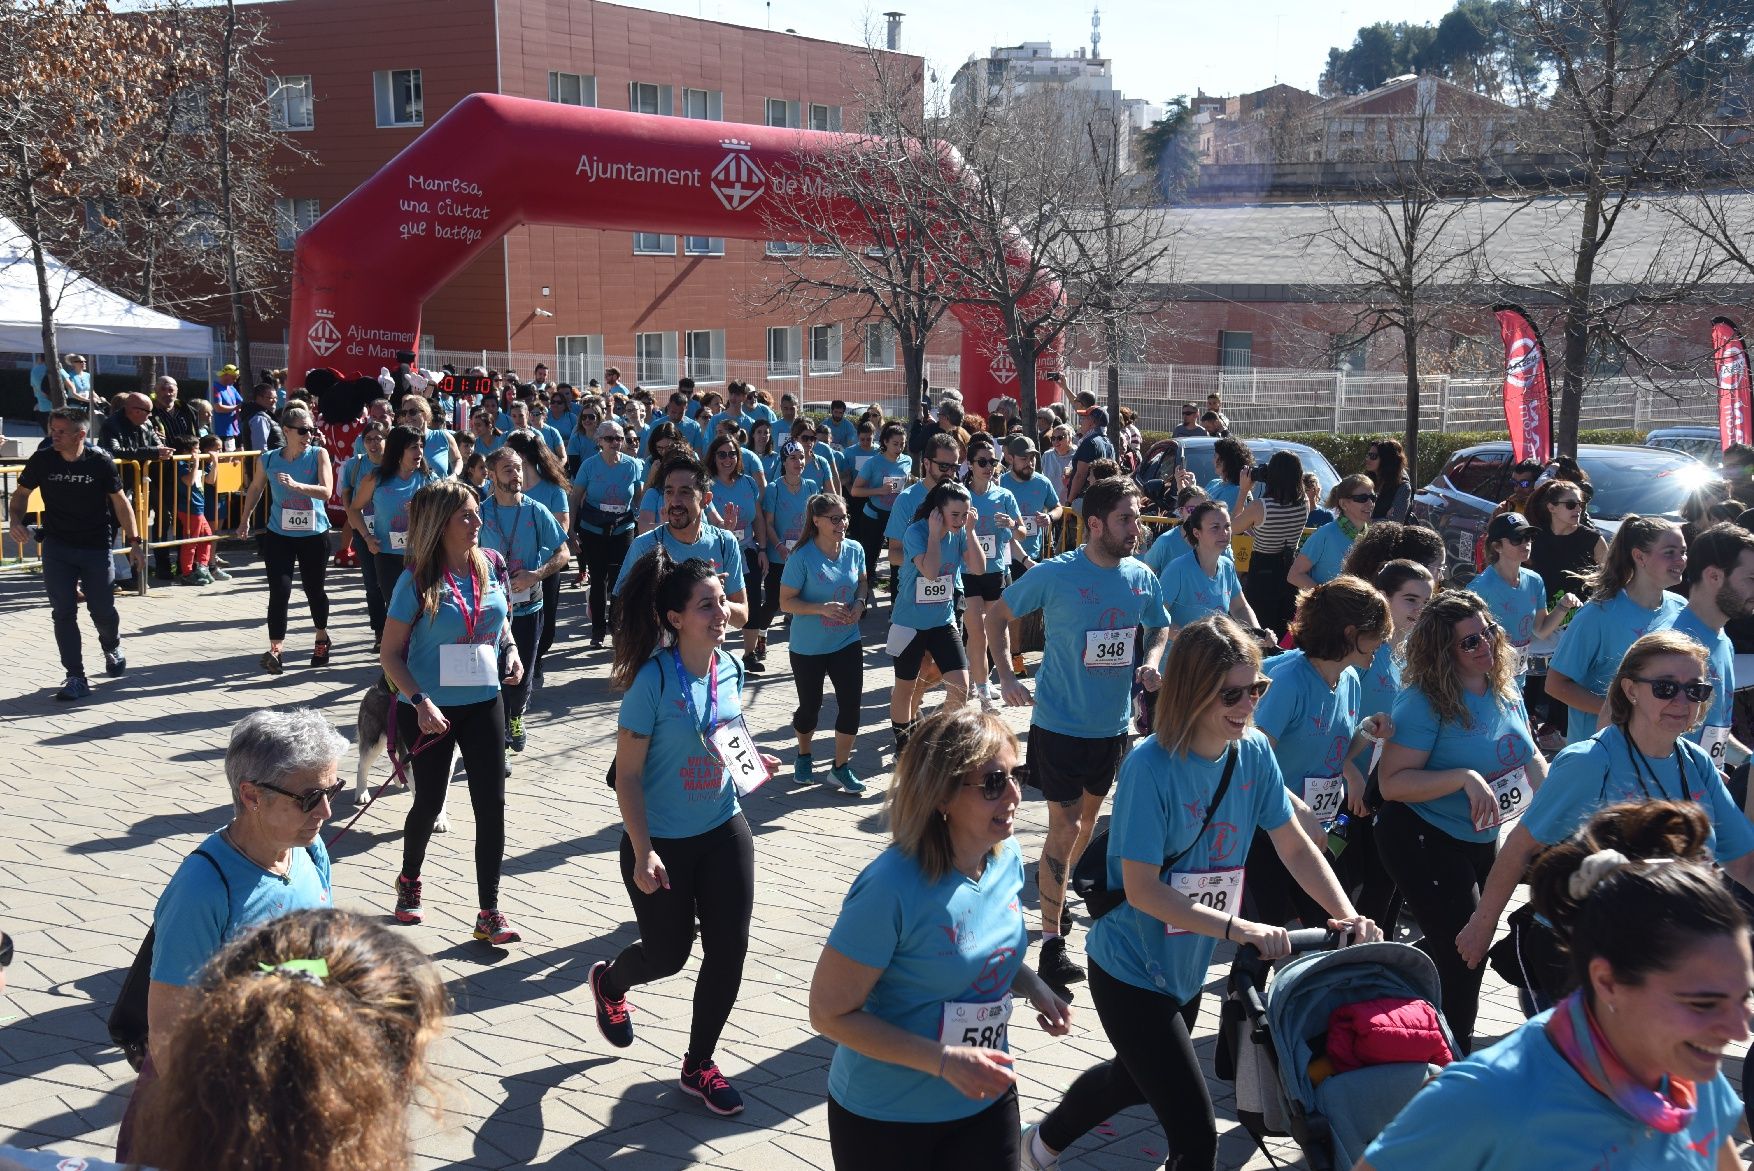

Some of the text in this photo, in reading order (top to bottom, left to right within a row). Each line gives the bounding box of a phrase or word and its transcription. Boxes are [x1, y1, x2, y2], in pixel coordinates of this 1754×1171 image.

[576, 154, 701, 187] Ajuntament
[409, 174, 483, 198] Manresa,
[773, 174, 798, 196] de
[400, 198, 491, 220] una ciutat
[400, 221, 482, 245] que batega
[347, 325, 415, 344] Ajuntament
[346, 342, 364, 357] de
[288, 515, 309, 526] 404
[924, 584, 946, 596] 699
[1096, 641, 1125, 659] 348
[727, 736, 755, 776] 214
[1312, 791, 1340, 812] 374
